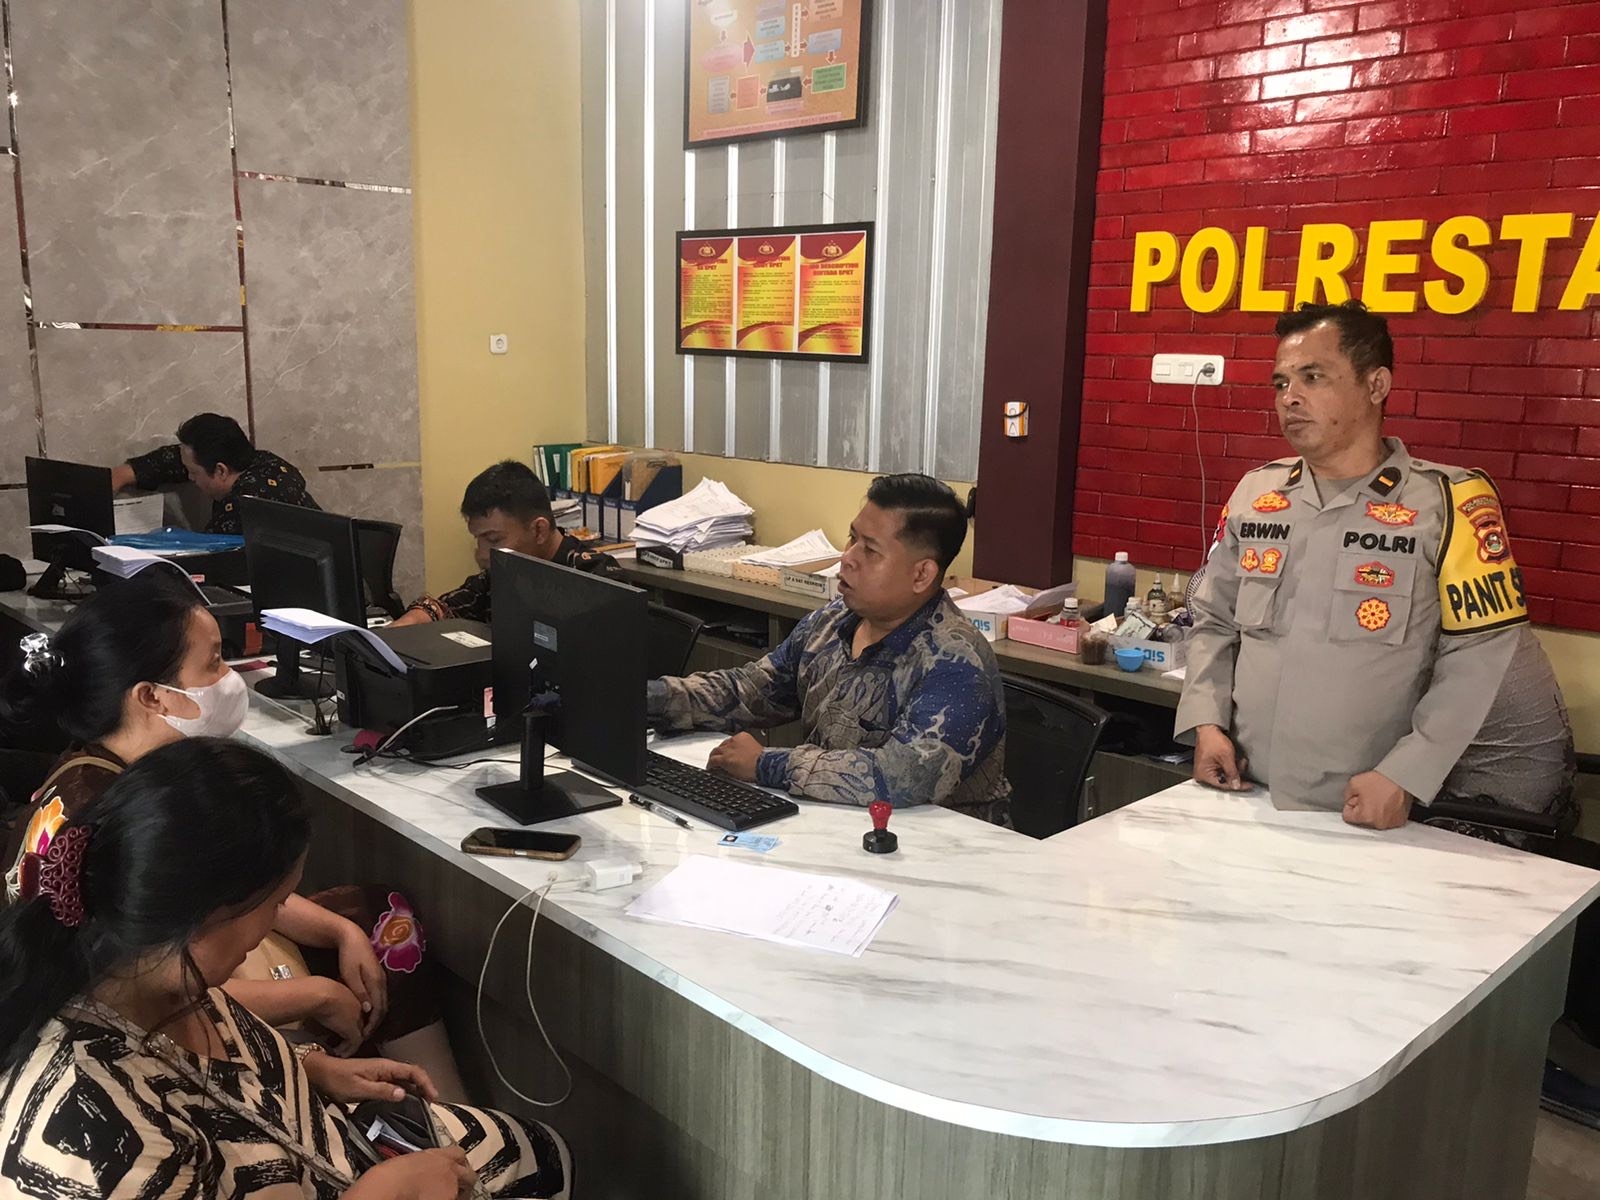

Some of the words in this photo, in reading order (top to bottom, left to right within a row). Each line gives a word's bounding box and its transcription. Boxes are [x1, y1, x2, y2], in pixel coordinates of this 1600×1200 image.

[1239, 522, 1290, 541] ERWIN
[1343, 531, 1416, 554] POLRI
[1446, 570, 1513, 622] PANIT
[1134, 647, 1165, 663] SiD
